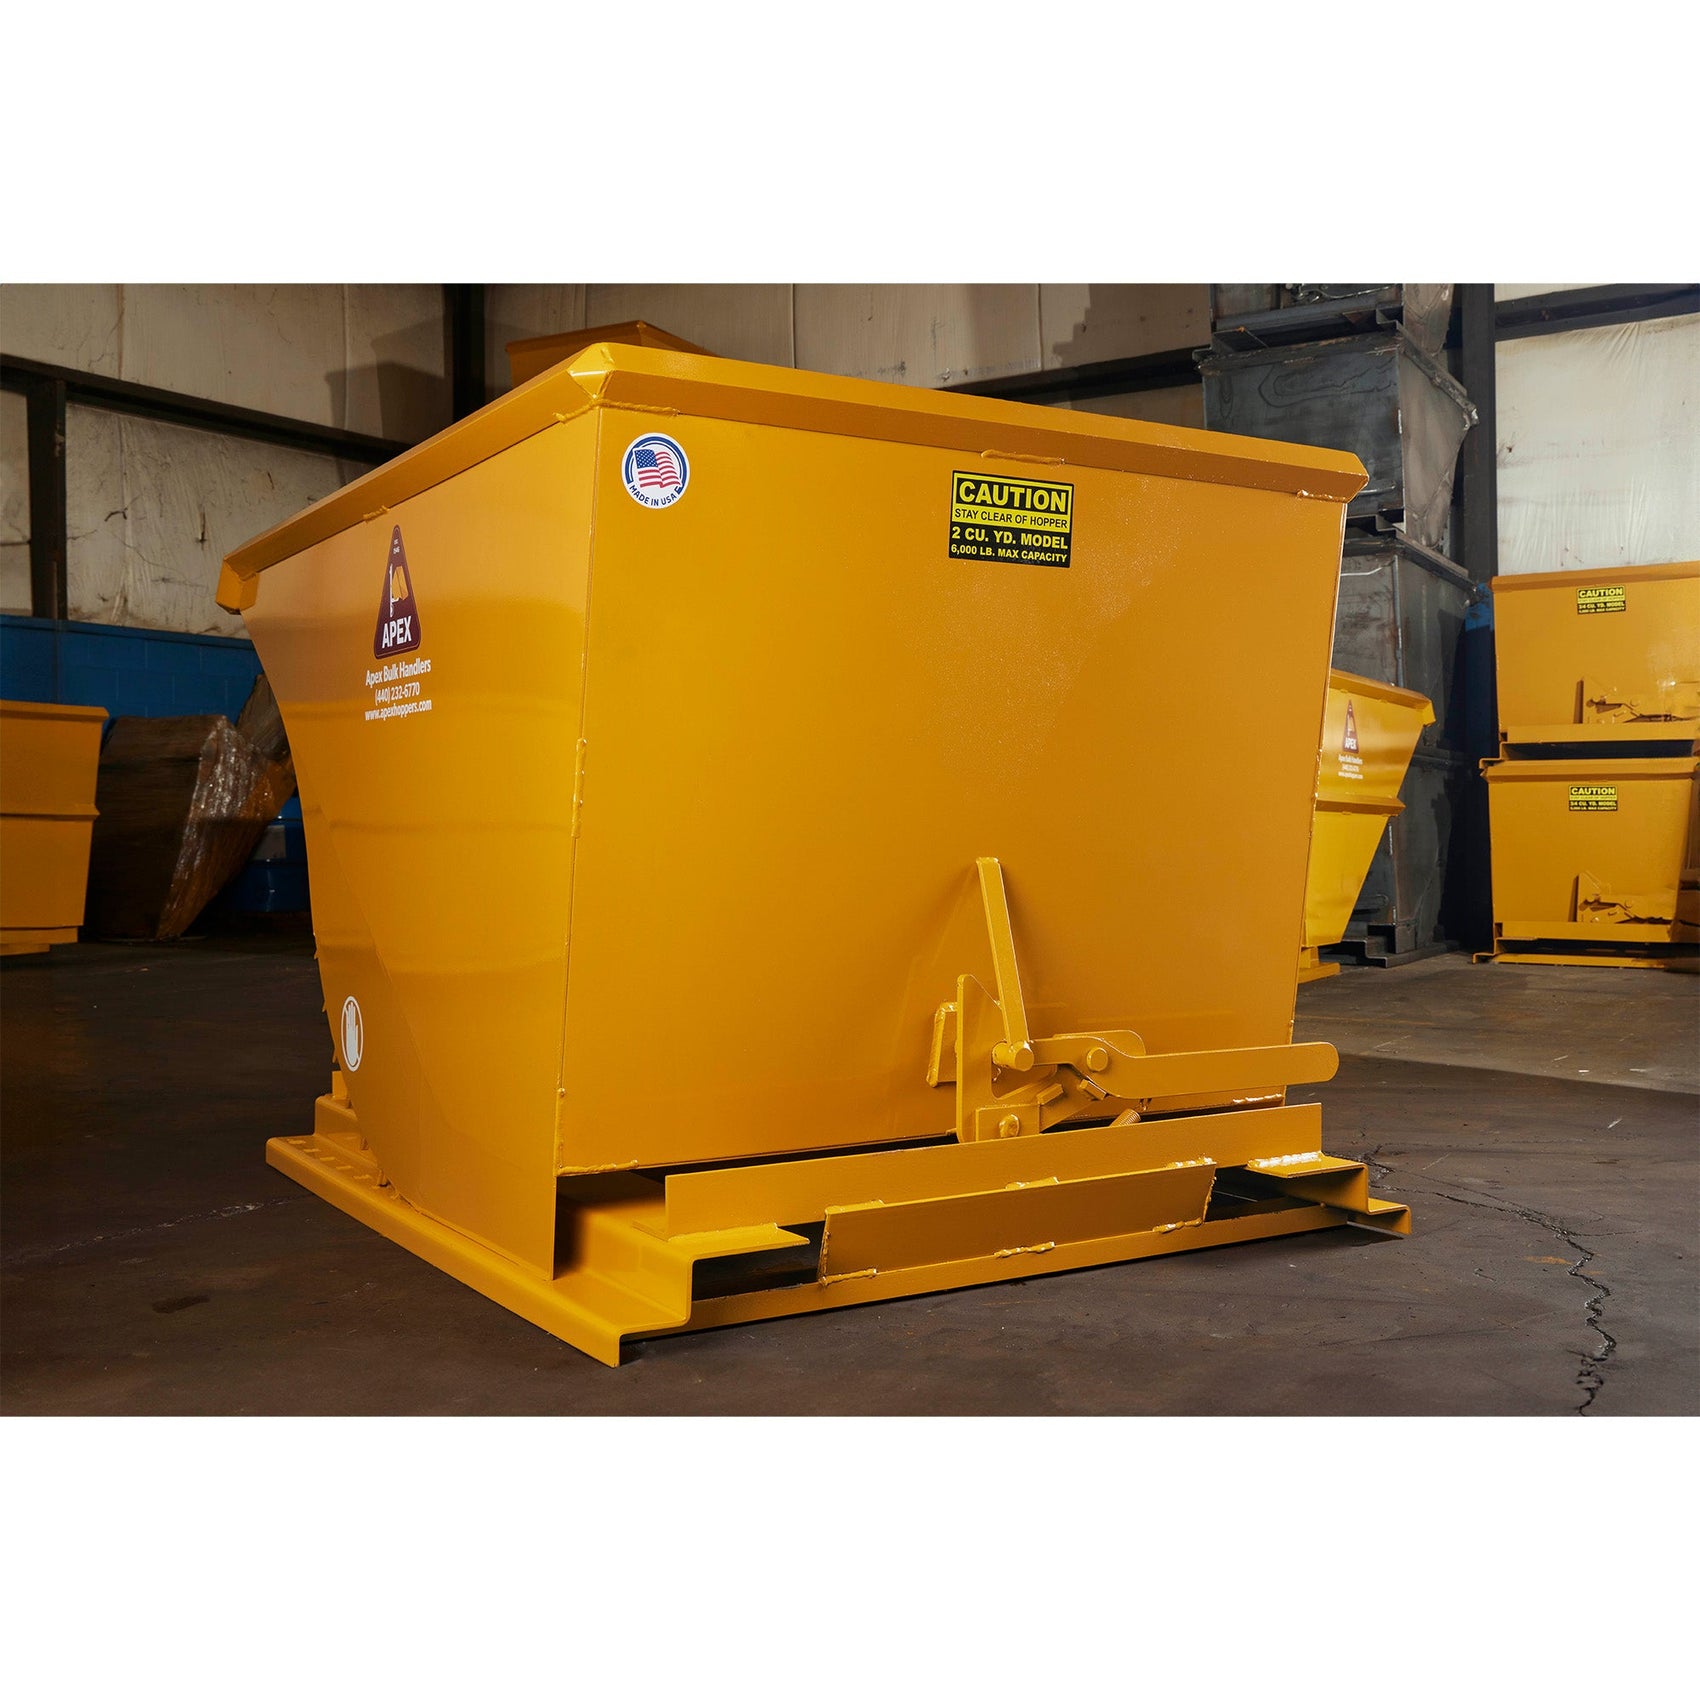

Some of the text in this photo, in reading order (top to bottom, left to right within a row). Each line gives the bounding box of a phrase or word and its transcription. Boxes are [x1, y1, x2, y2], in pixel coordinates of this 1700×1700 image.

[629, 485, 650, 505] MADE
[661, 493, 677, 506] USA
[959, 481, 1067, 512] CAUTION
[955, 508, 1067, 528] STAY CLEAR OF HOPPER
[952, 526, 1068, 549] 2 CU. YD. MODEL
[951, 544, 1067, 563] 6,000 LB. MAX CAPACITY
[1579, 588, 1623, 598] CAUTION
[382, 615, 412, 648] APEX
[365, 657, 431, 688] Apex Bulk Handlers
[375, 686, 391, 706] (440)
[364, 699, 432, 721] www.apexhoppers.com
[1571, 787, 1615, 795] CAUTION
